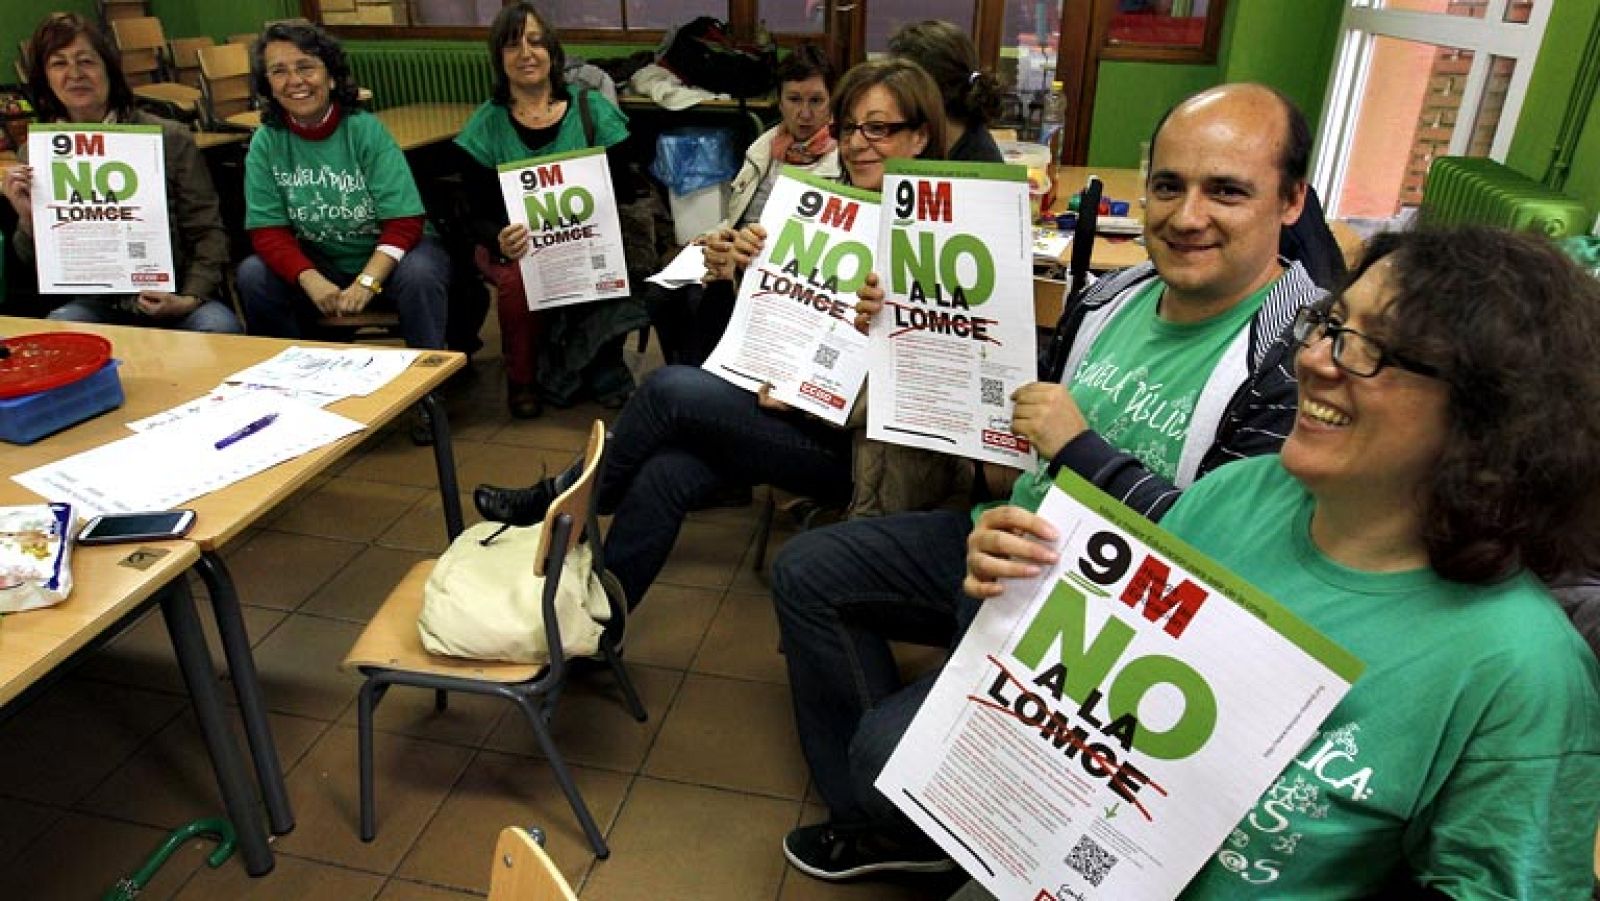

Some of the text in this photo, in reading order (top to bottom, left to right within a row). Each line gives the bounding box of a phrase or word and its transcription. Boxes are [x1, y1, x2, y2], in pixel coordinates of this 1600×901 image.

[52, 133, 105, 157] 9M
[52, 161, 138, 201] NO
[70, 190, 119, 204] A LA
[520, 164, 564, 190] 9M
[523, 186, 594, 231] NO
[797, 191, 860, 232] 9M
[895, 179, 953, 223] 9M
[768, 219, 873, 293] NO
[781, 258, 838, 294] A LA
[891, 229, 995, 306] NO
[910, 278, 969, 311] A LA
[895, 304, 988, 340] LOMCE
[1078, 531, 1209, 639] 9M
[1011, 578, 1218, 761] NO
[1033, 662, 1137, 753] A LA
[988, 670, 1152, 804] LOMCE
